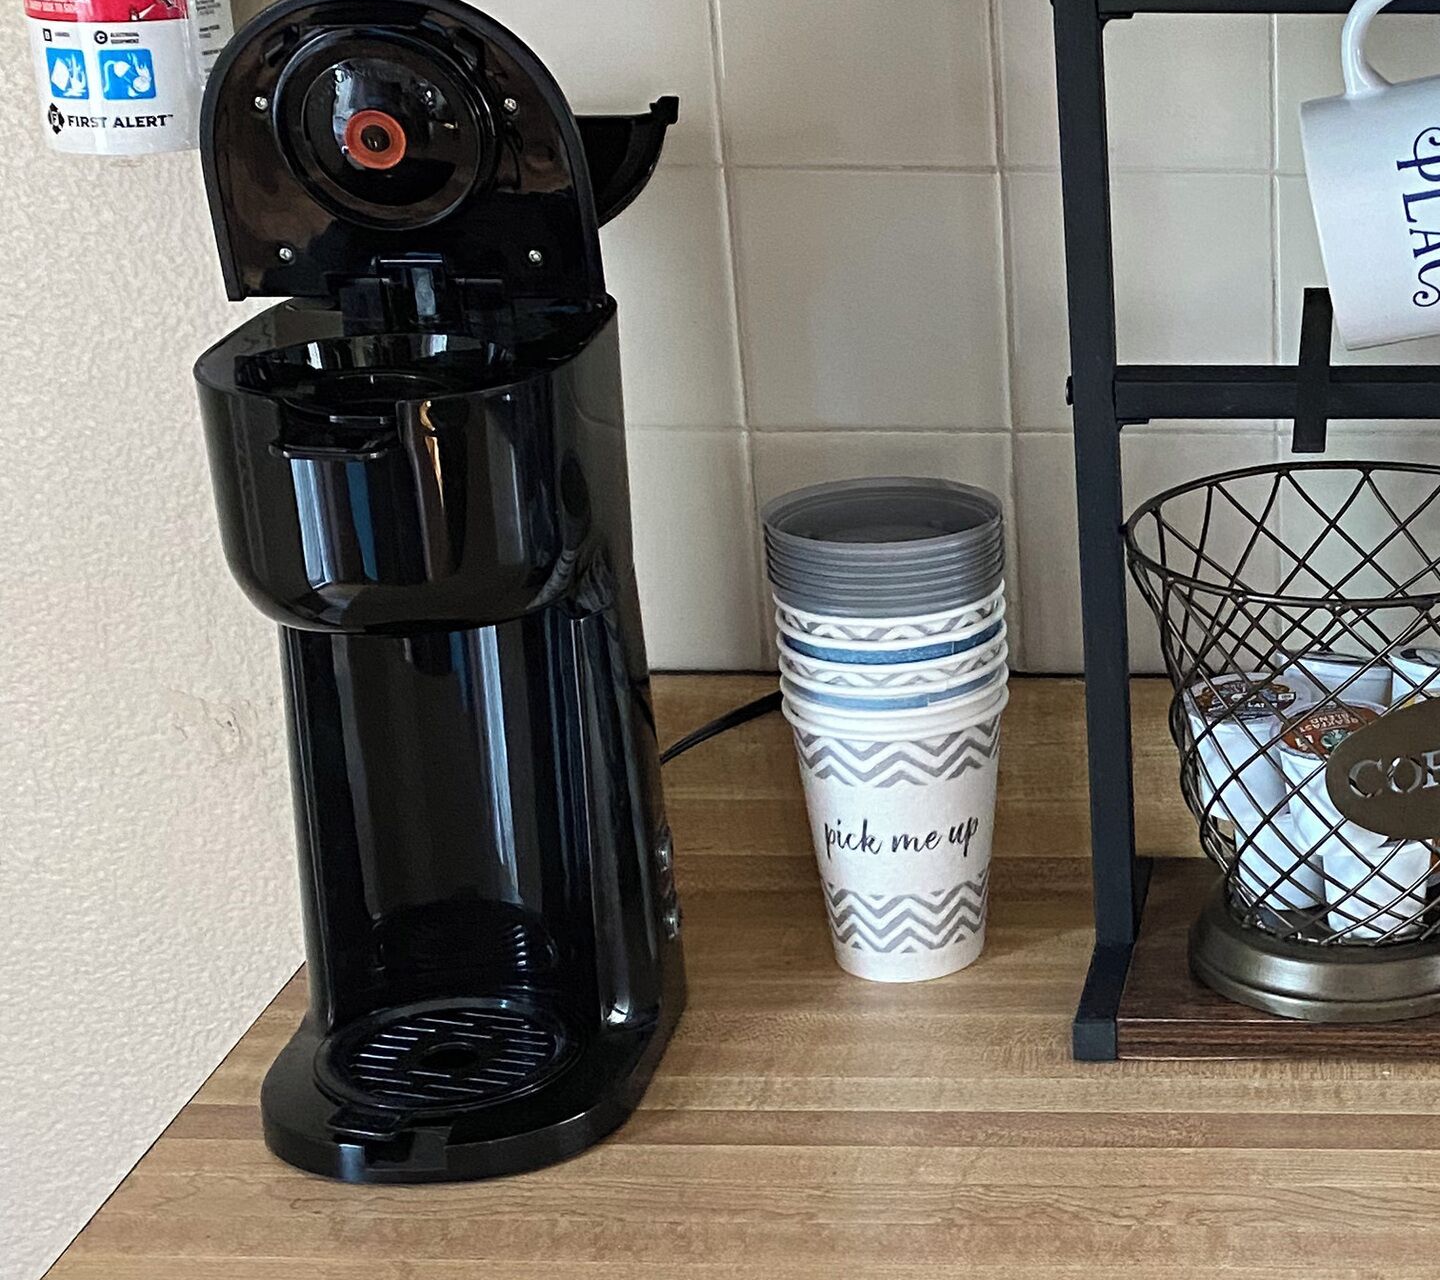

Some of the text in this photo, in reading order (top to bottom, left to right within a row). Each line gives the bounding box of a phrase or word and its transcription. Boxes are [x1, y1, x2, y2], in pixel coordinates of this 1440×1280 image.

[67, 115, 107, 129] FIRST
[824, 816, 979, 860] pick me up
